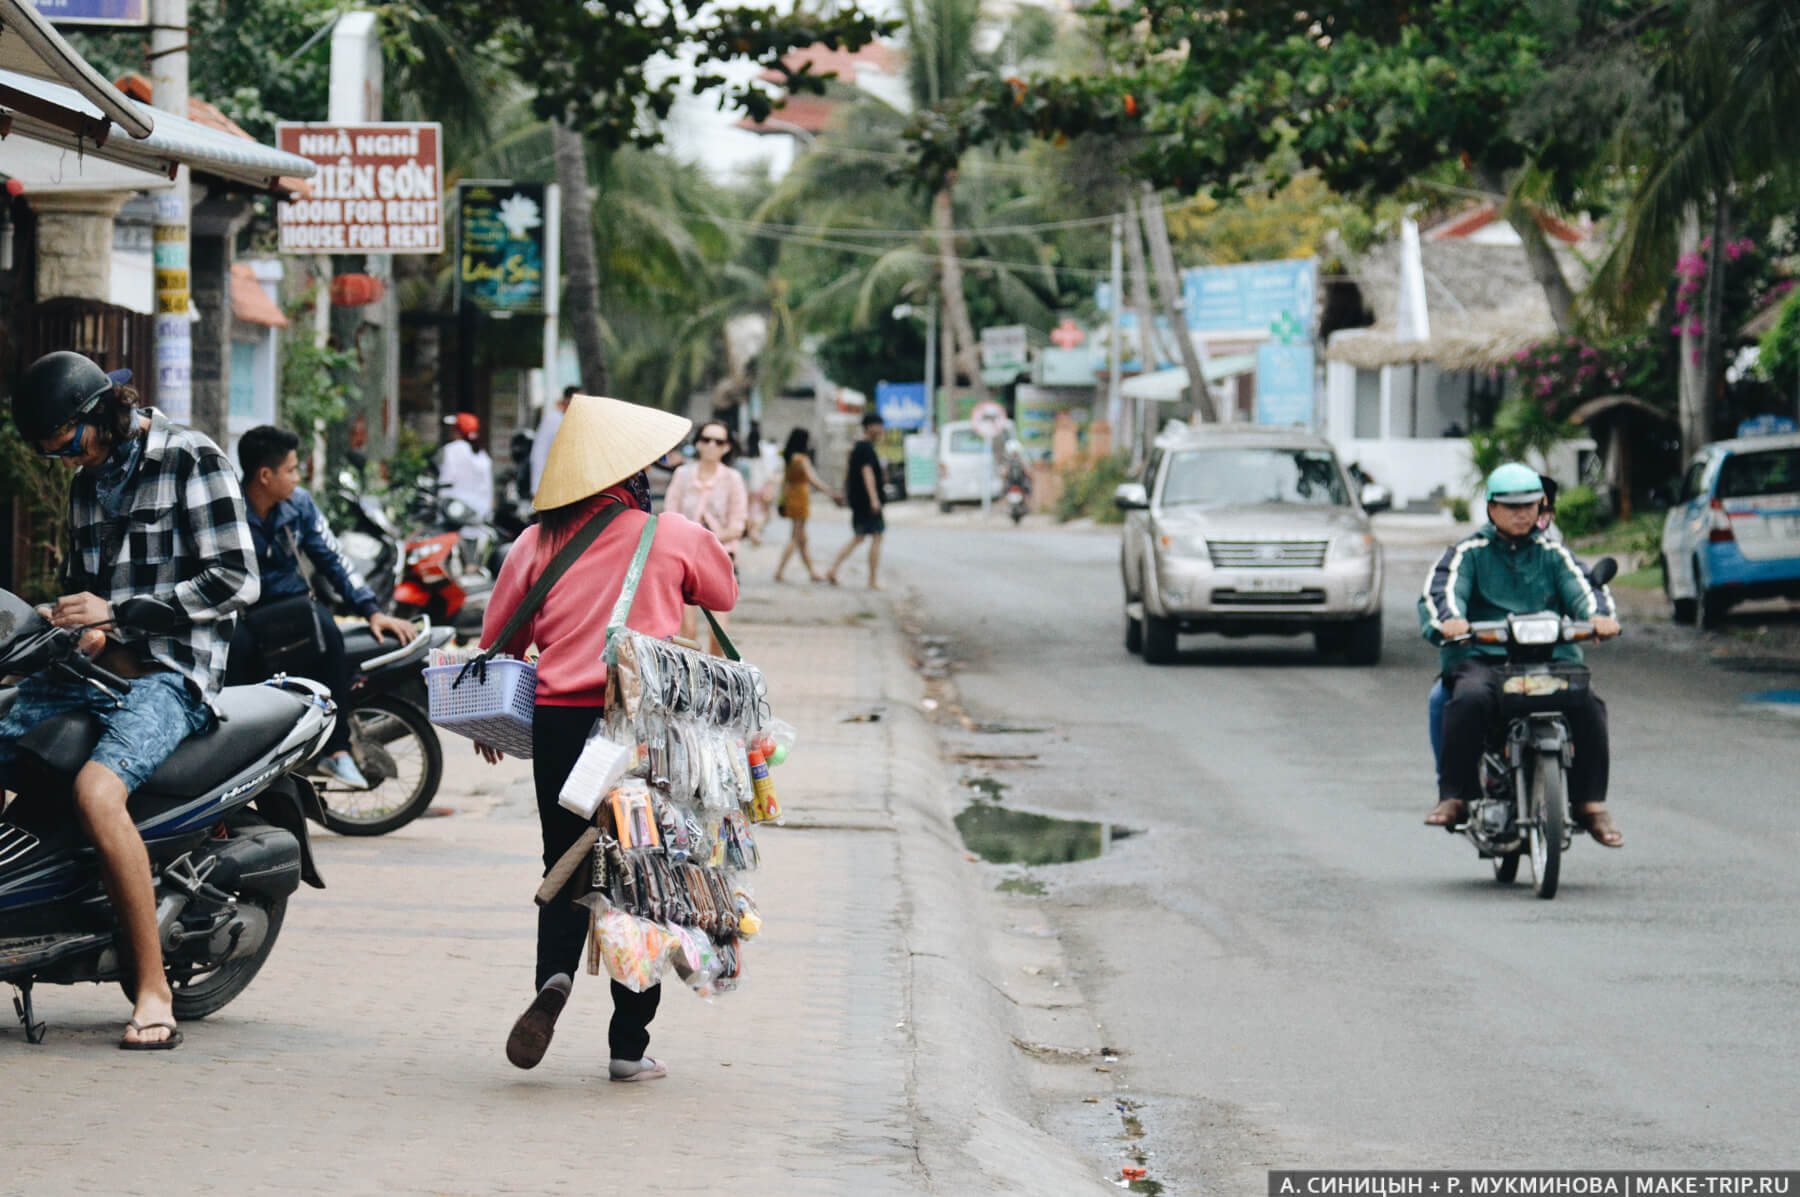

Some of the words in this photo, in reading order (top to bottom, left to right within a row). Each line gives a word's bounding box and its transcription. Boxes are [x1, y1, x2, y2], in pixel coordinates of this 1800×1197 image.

[282, 200, 341, 223] ROOM
[344, 200, 383, 223] FOR
[386, 200, 437, 223] RENT
[283, 224, 346, 247] HOUSE
[348, 224, 386, 247] FOR
[388, 224, 437, 247] RENT
